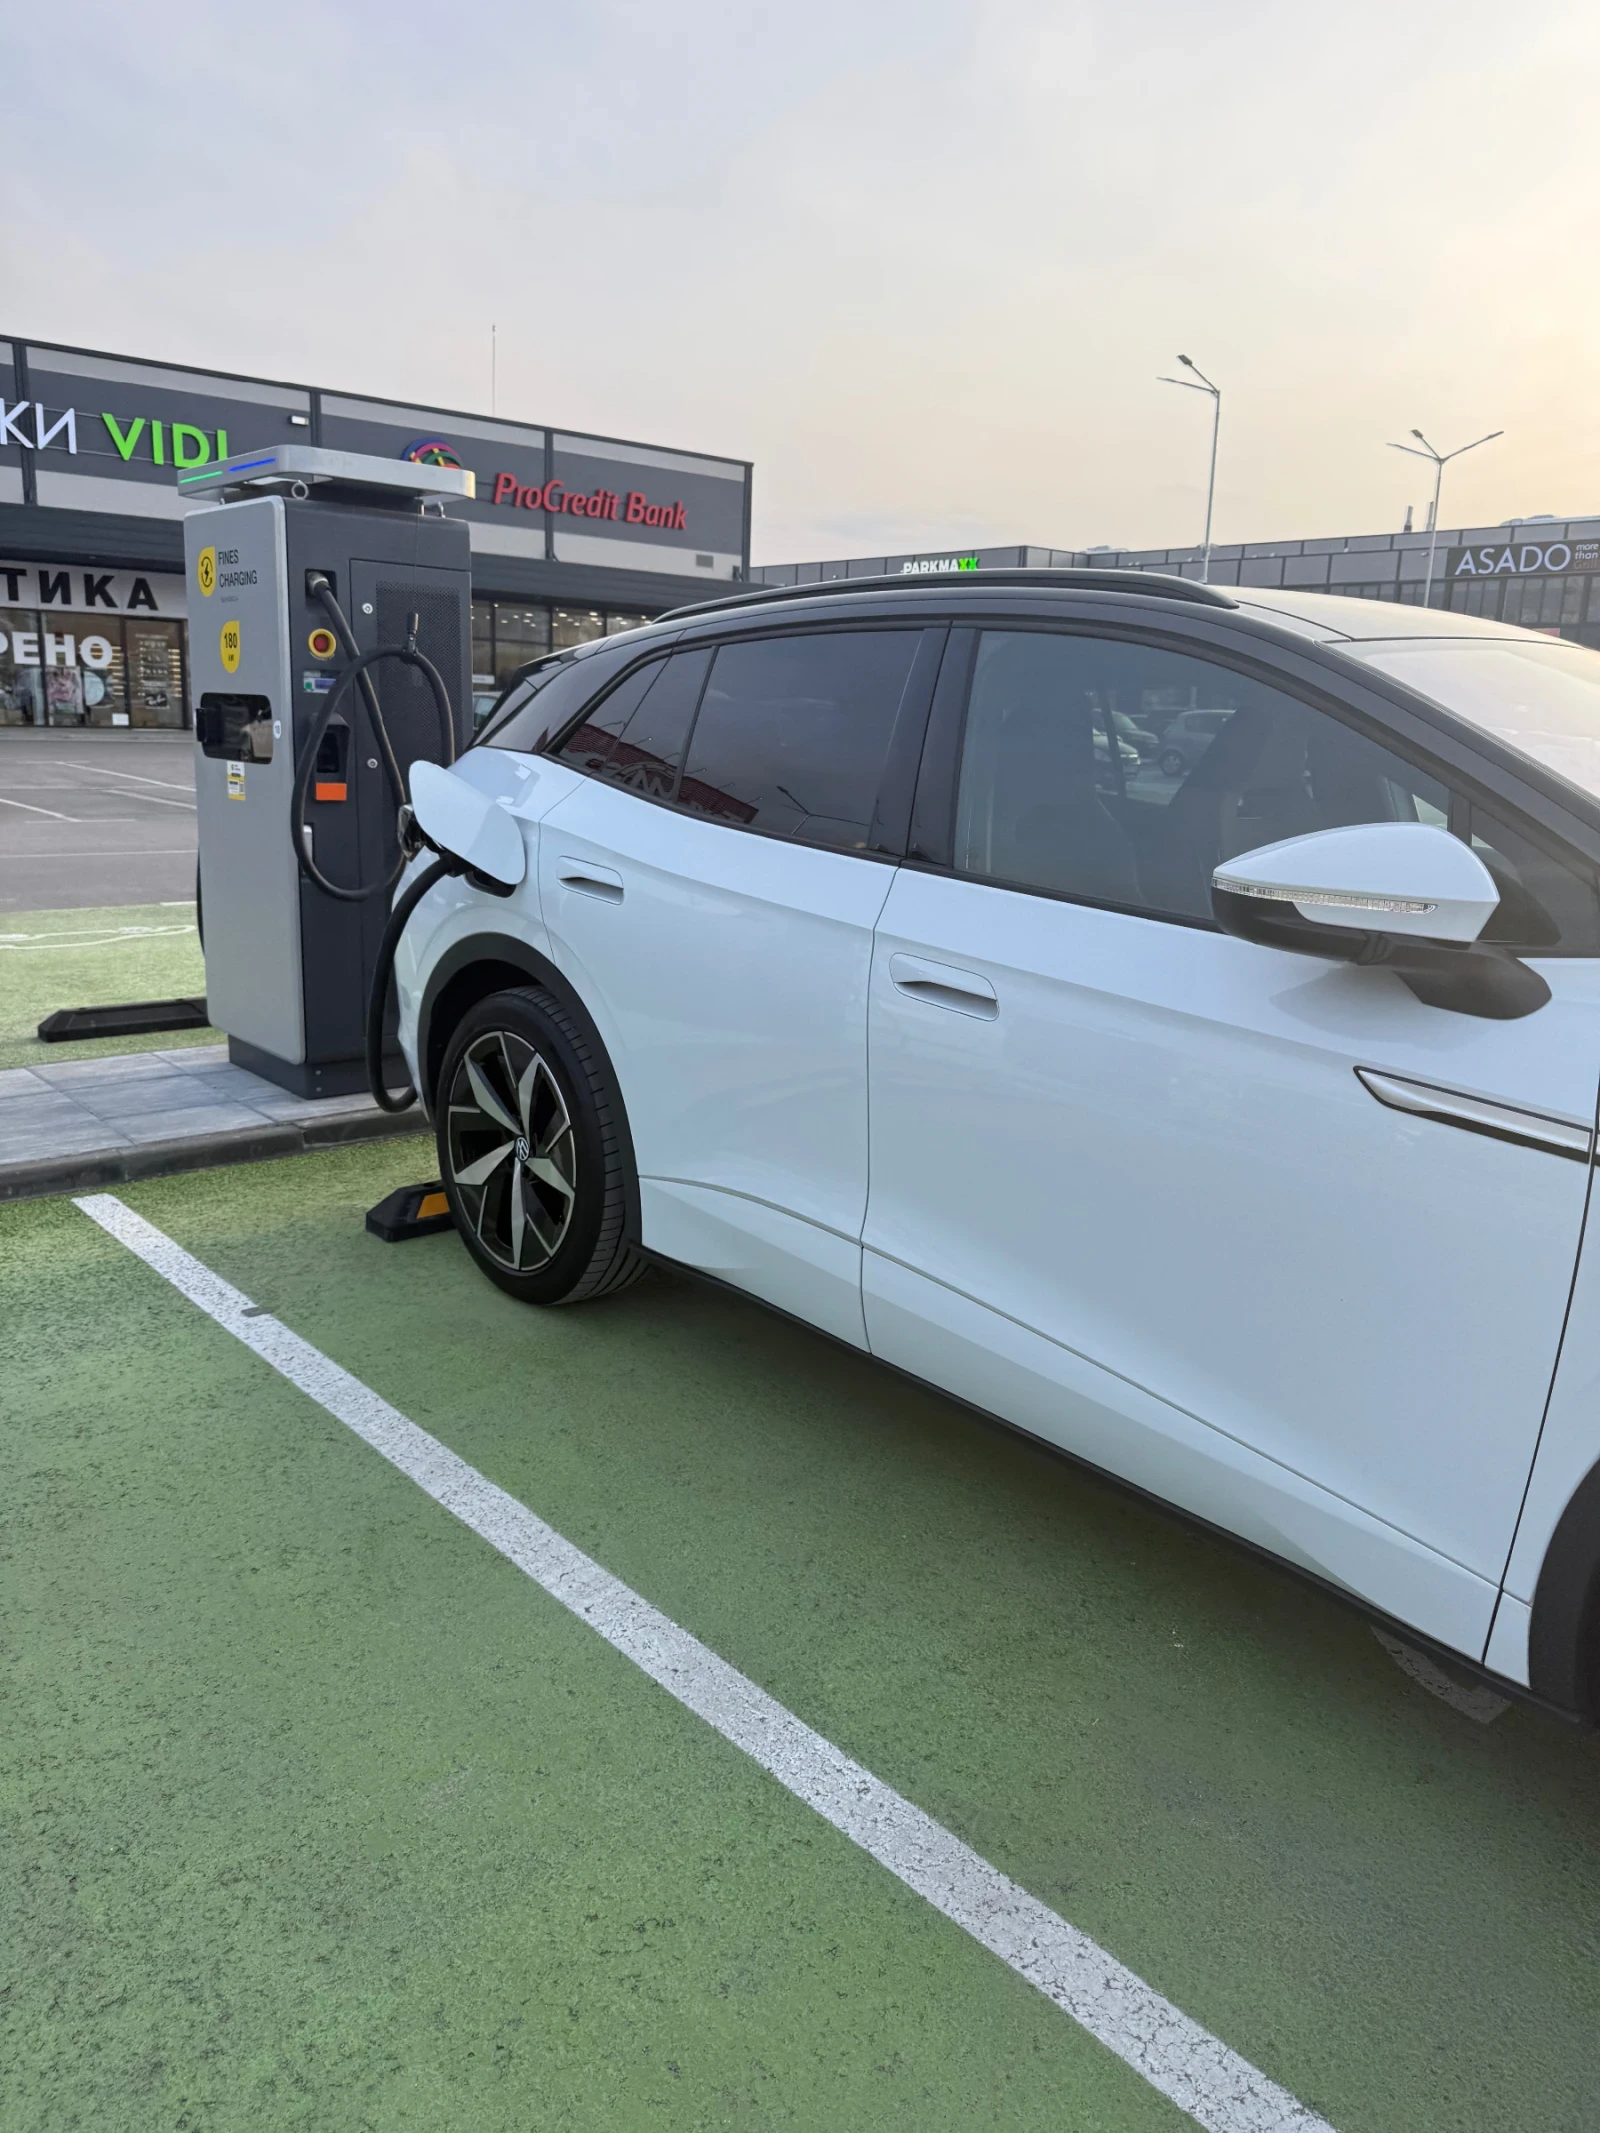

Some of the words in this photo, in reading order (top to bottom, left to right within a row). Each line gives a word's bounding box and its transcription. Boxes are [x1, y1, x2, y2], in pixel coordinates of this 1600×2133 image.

[102, 412, 228, 468] VIDI
[493, 472, 620, 520] ProCredit
[625, 491, 689, 530] Bank
[1575, 551, 1598, 560] than
[1576, 543, 1600, 551] more
[218, 549, 239, 565] FINES
[903, 557, 979, 574] PARKMAXX
[1454, 543, 1571, 575] ASADO
[219, 569, 258, 588] CHARGING
[0, 567, 159, 611] ТИКА
[224, 632, 238, 649] 180
